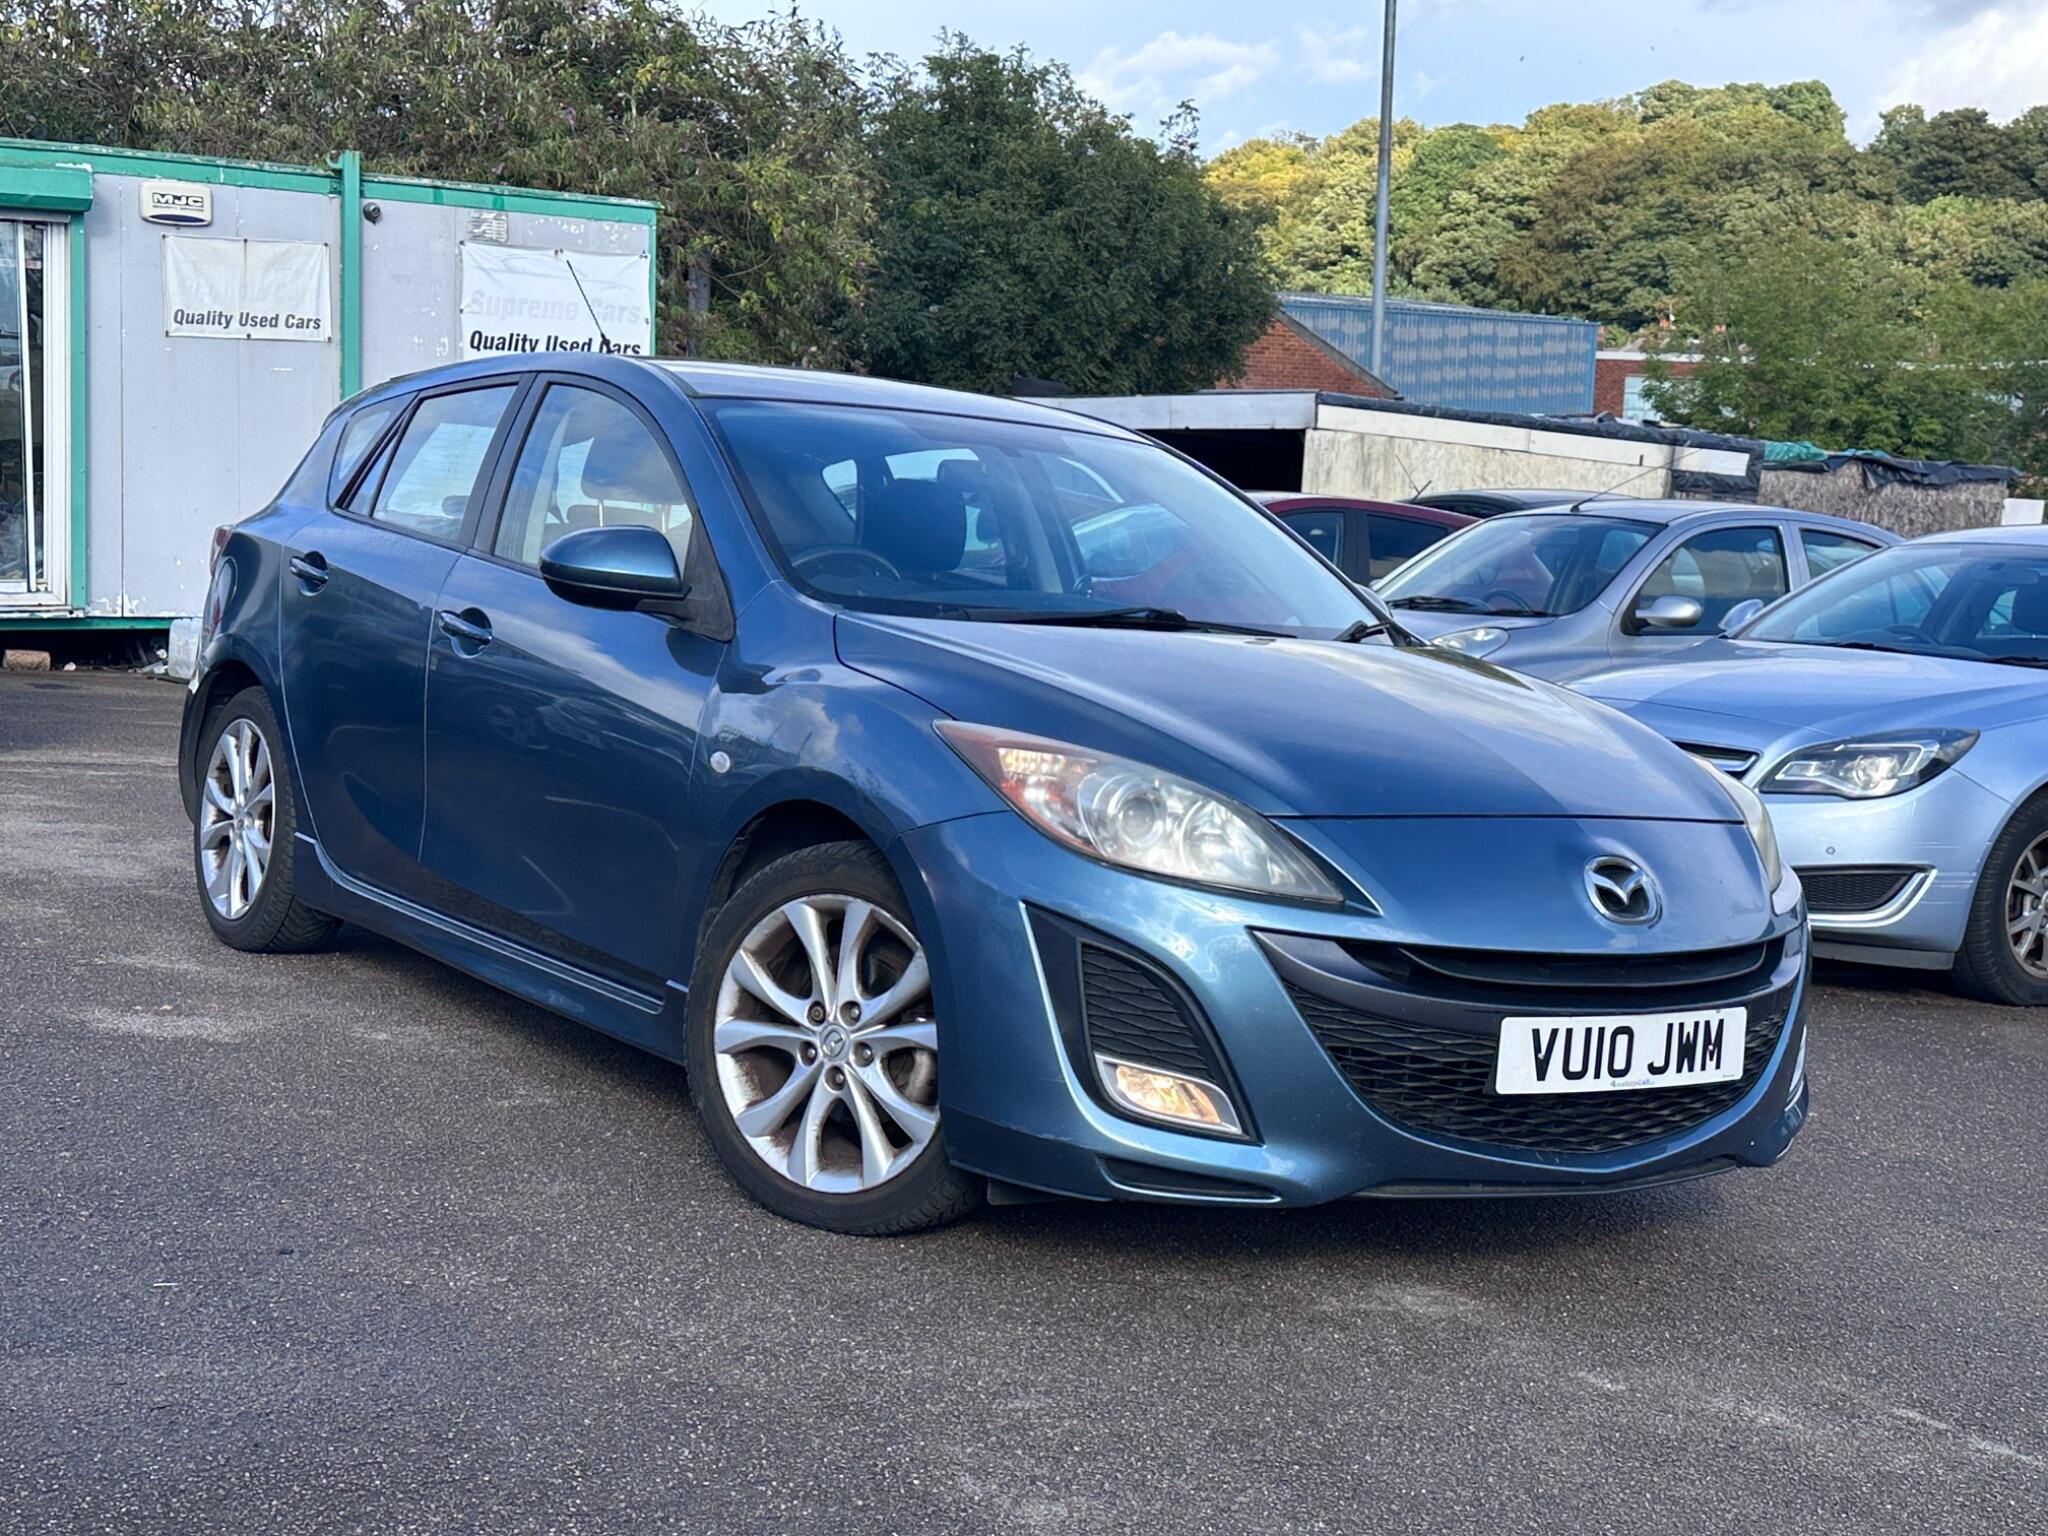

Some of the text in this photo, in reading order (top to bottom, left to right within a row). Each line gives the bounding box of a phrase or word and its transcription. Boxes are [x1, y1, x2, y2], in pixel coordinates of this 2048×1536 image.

[152, 192, 204, 207] MJC
[471, 289, 579, 321] Supreme
[173, 308, 321, 330] Quality Used Cars
[469, 330, 539, 353] Quality
[545, 335, 592, 353] Used
[1531, 1018, 1725, 1082] VU10 JWM
